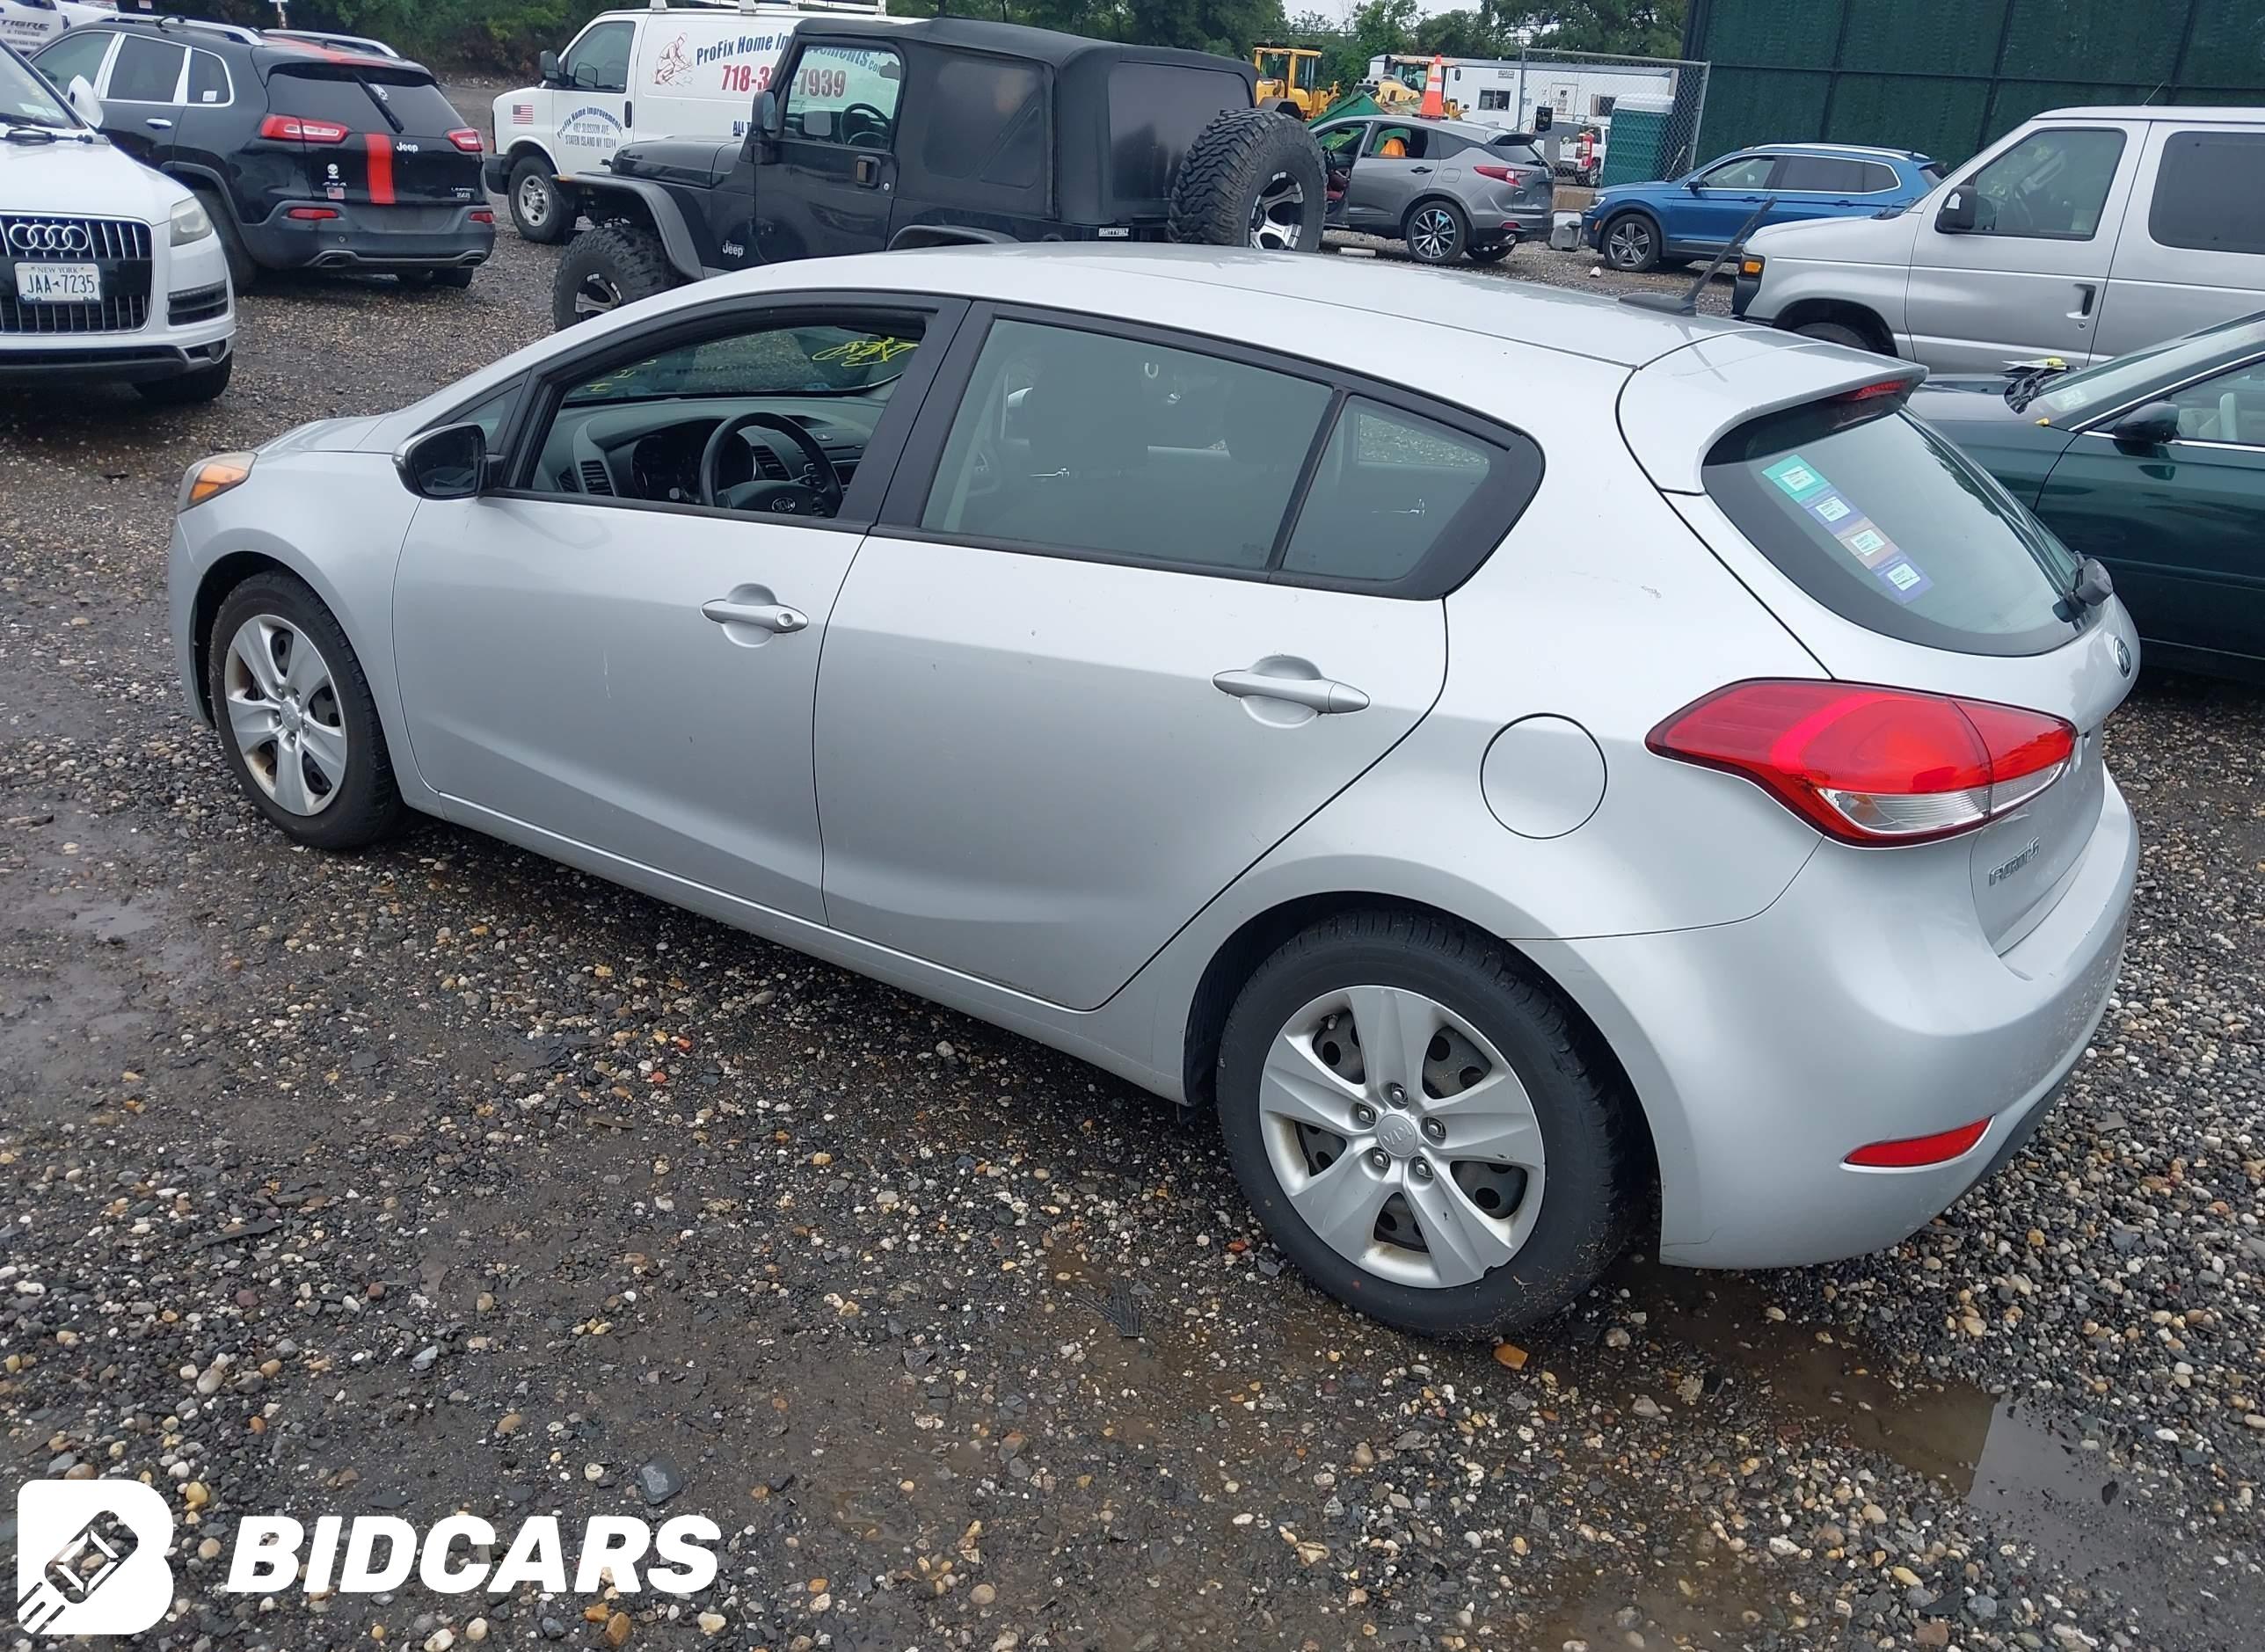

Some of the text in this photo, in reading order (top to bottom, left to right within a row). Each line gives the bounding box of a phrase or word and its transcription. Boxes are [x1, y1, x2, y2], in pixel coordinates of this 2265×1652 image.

[696, 39, 734, 66] ProFix
[737, 35, 773, 55] Home
[571, 107, 586, 122] Home
[396, 142, 419, 154] Jeep
[722, 239, 744, 258] Jeep
